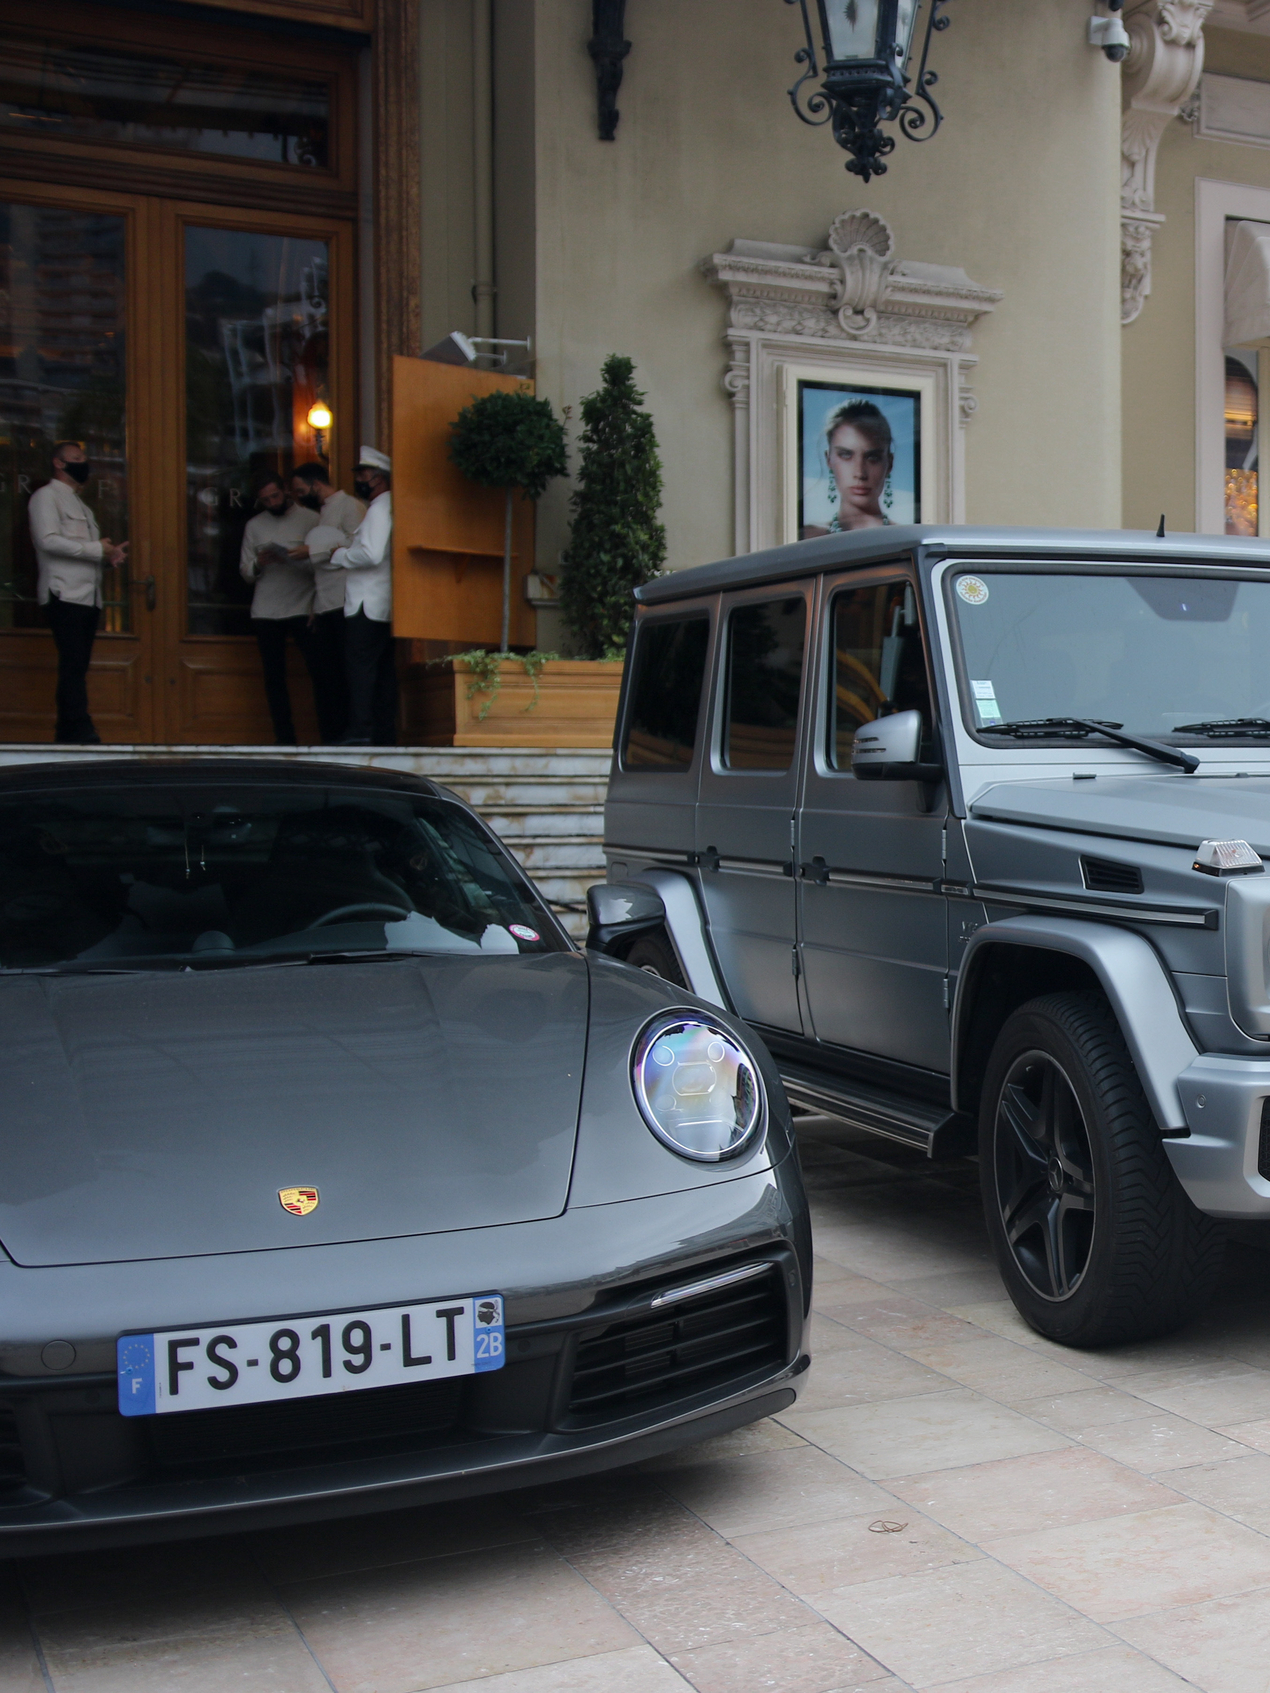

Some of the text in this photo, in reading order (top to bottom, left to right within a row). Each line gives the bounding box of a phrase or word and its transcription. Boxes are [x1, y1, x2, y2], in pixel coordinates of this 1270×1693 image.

[131, 1378, 143, 1394] F
[168, 1306, 465, 1396] FS-819-LT
[476, 1332, 503, 1359] 2B
